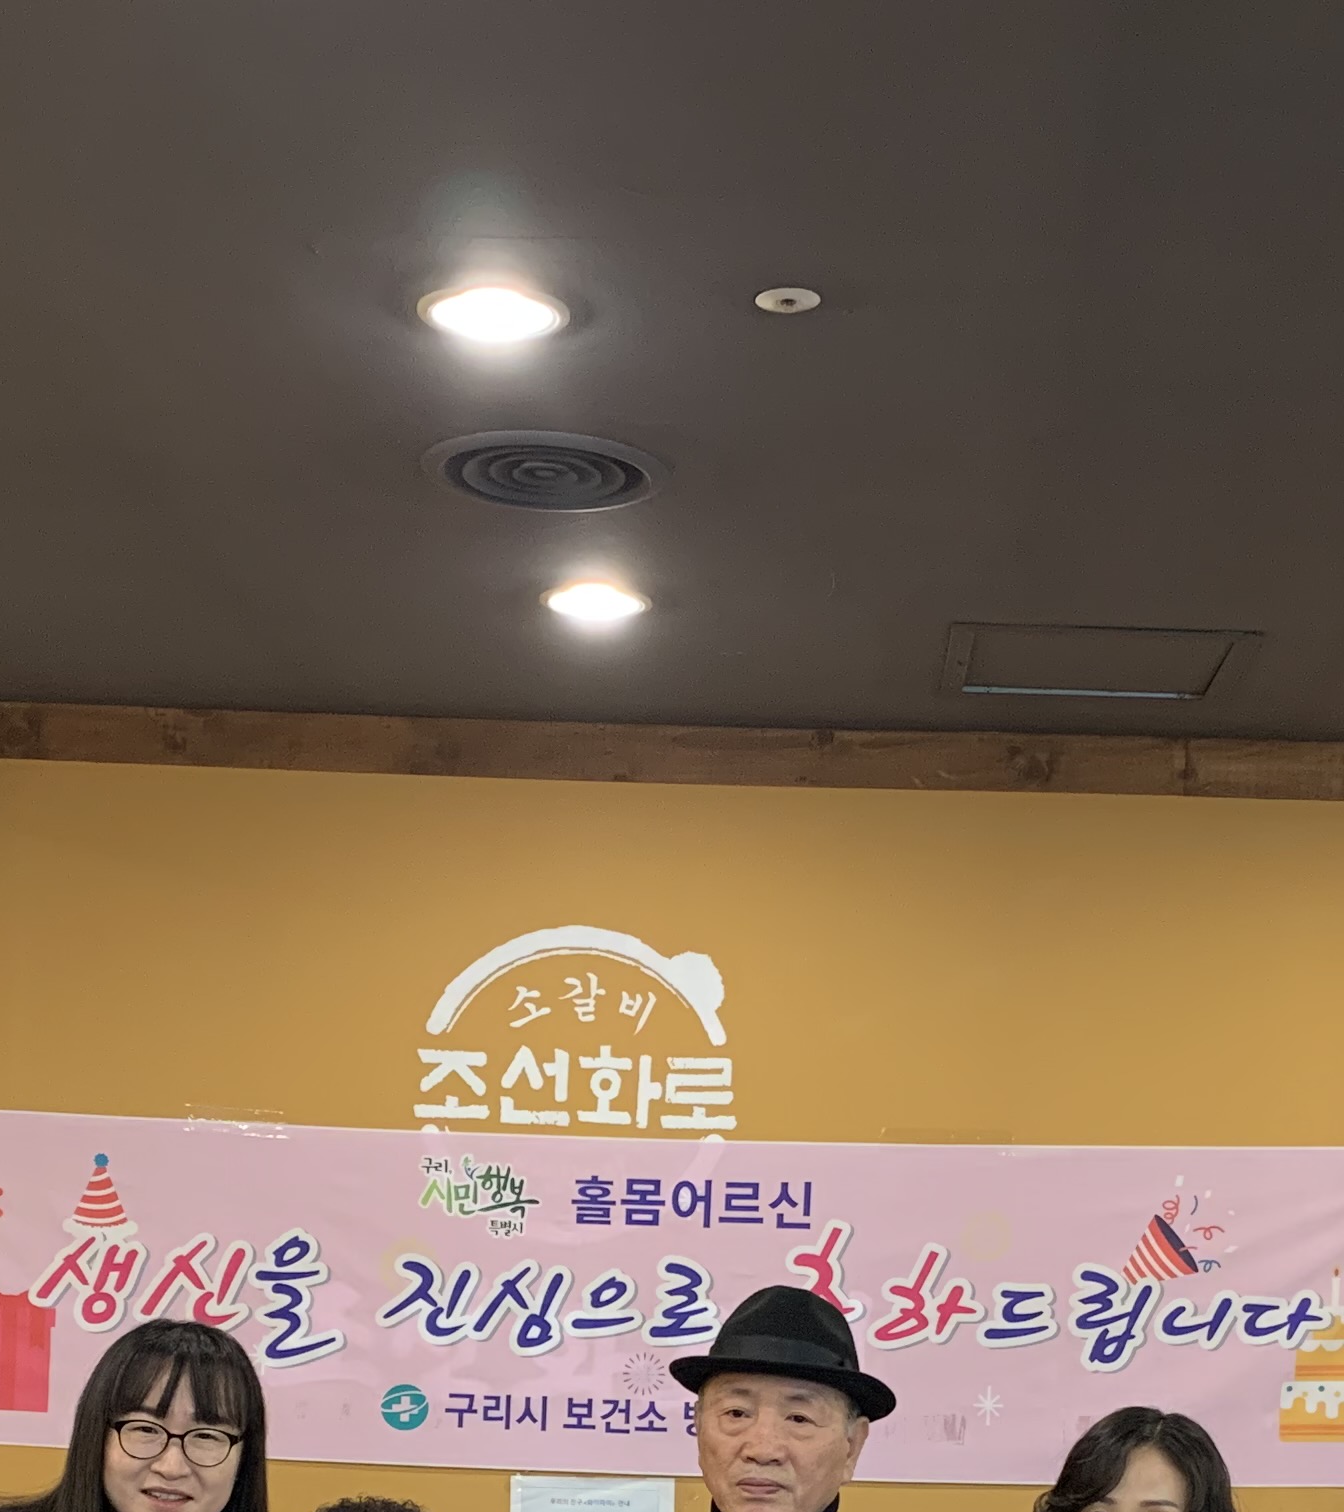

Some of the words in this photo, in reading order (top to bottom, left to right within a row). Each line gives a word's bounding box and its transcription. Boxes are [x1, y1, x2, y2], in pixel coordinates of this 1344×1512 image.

[507, 972, 657, 1036] 소갈비
[412, 1045, 738, 1129] 조선화로
[488, 1219, 524, 1237] 특별시
[571, 1176, 814, 1231] 홀몸어르신
[36, 1233, 338, 1361] 생신을
[381, 1257, 718, 1350] 진심으로
[444, 1392, 548, 1431] 구리시
[562, 1397, 668, 1435] 보건소
